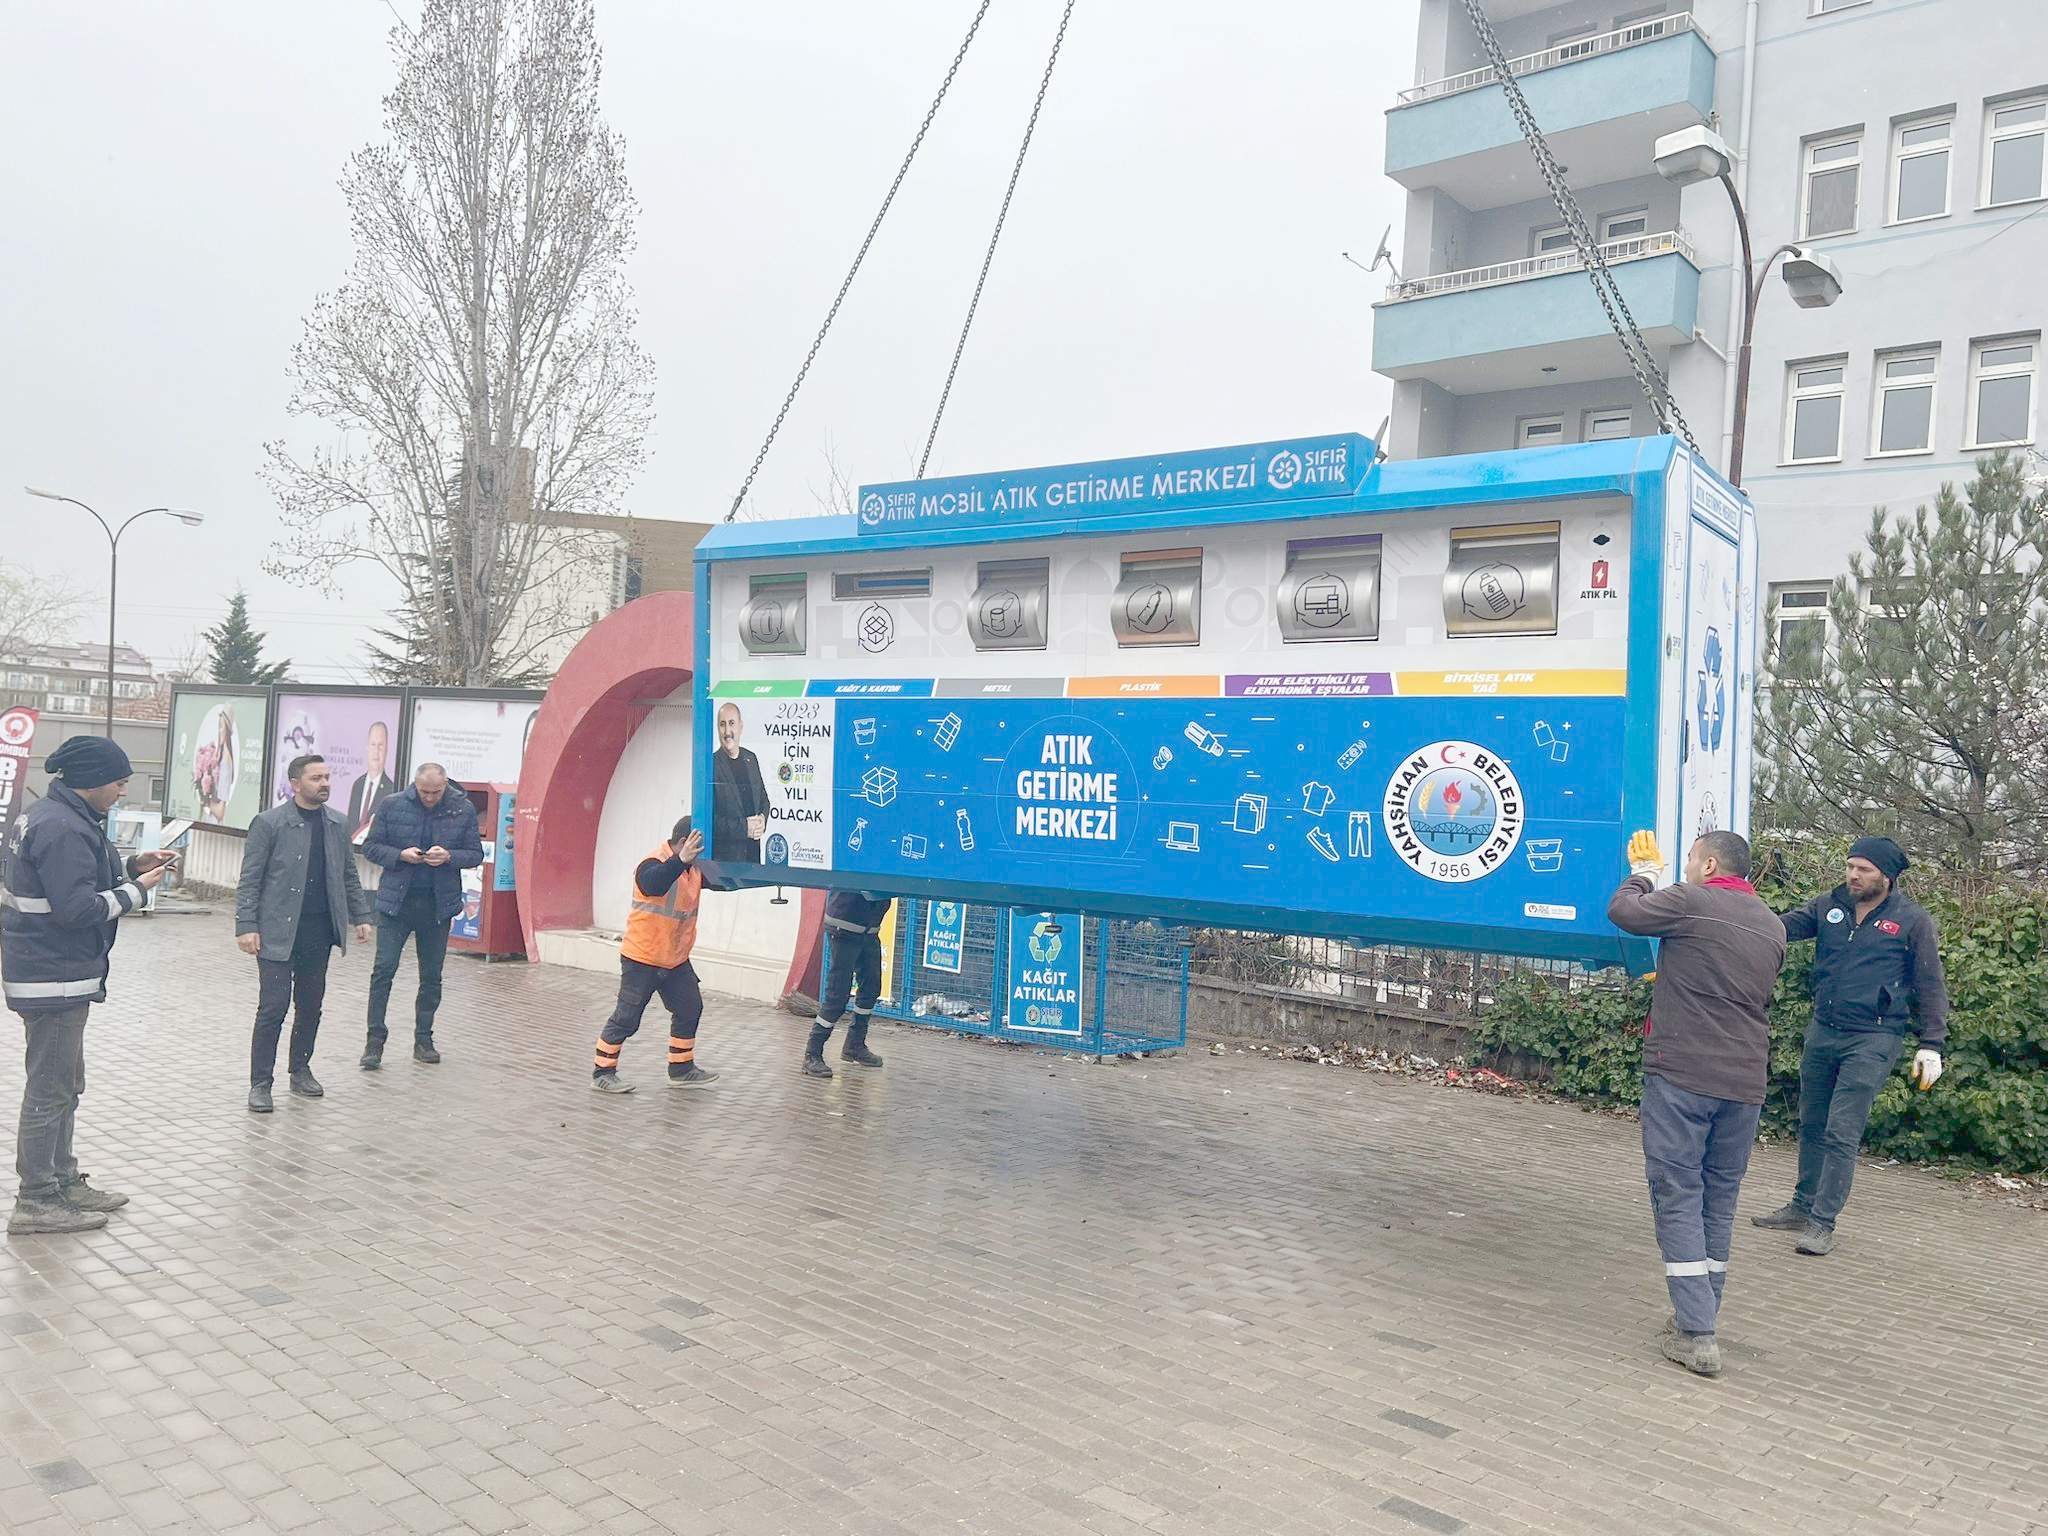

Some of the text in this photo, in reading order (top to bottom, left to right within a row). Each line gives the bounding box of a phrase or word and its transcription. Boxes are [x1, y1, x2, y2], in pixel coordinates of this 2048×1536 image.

[1304, 448, 1347, 466] SIFIR
[1304, 464, 1346, 484] ATIK
[920, 457, 1256, 517] MOBİL ATIK GETİRME MERKEZİ
[888, 492, 916, 507] SIFIR
[888, 505, 915, 521] ATIK
[1580, 588, 1618, 599] ATIK PİL
[1255, 674, 1368, 686] ATIK ELEKTRİKLİ VE
[1443, 672, 1536, 683] BİTKİSEL ATIK
[982, 684, 1013, 693] METAL
[1120, 681, 1163, 692] PLASTİK
[1243, 685, 1370, 696] ELEKTRONİK EŞYALAR
[776, 703, 820, 719] 2023
[764, 721, 831, 741] YAHŞİHAN
[784, 742, 810, 762] İÇİN
[1041, 735, 1093, 765] ATIK
[794, 764, 815, 774] SIFIR
[794, 774, 814, 784] ATIK
[1017, 766, 1118, 803] GETİRME
[784, 787, 808, 801] YILI
[770, 807, 823, 823] OLACAK
[1387, 754, 1520, 870] YAHŞİHAN BELEDİYESİ
[1016, 805, 1117, 841] MERKEZİ
[1430, 861, 1470, 878] 1956
[933, 930, 957, 941] KAĞIT
[928, 938, 960, 951] ATIKLAR
[1023, 967, 1067, 985] KAĞIT
[1013, 986, 1076, 1003] ATIKLAR
